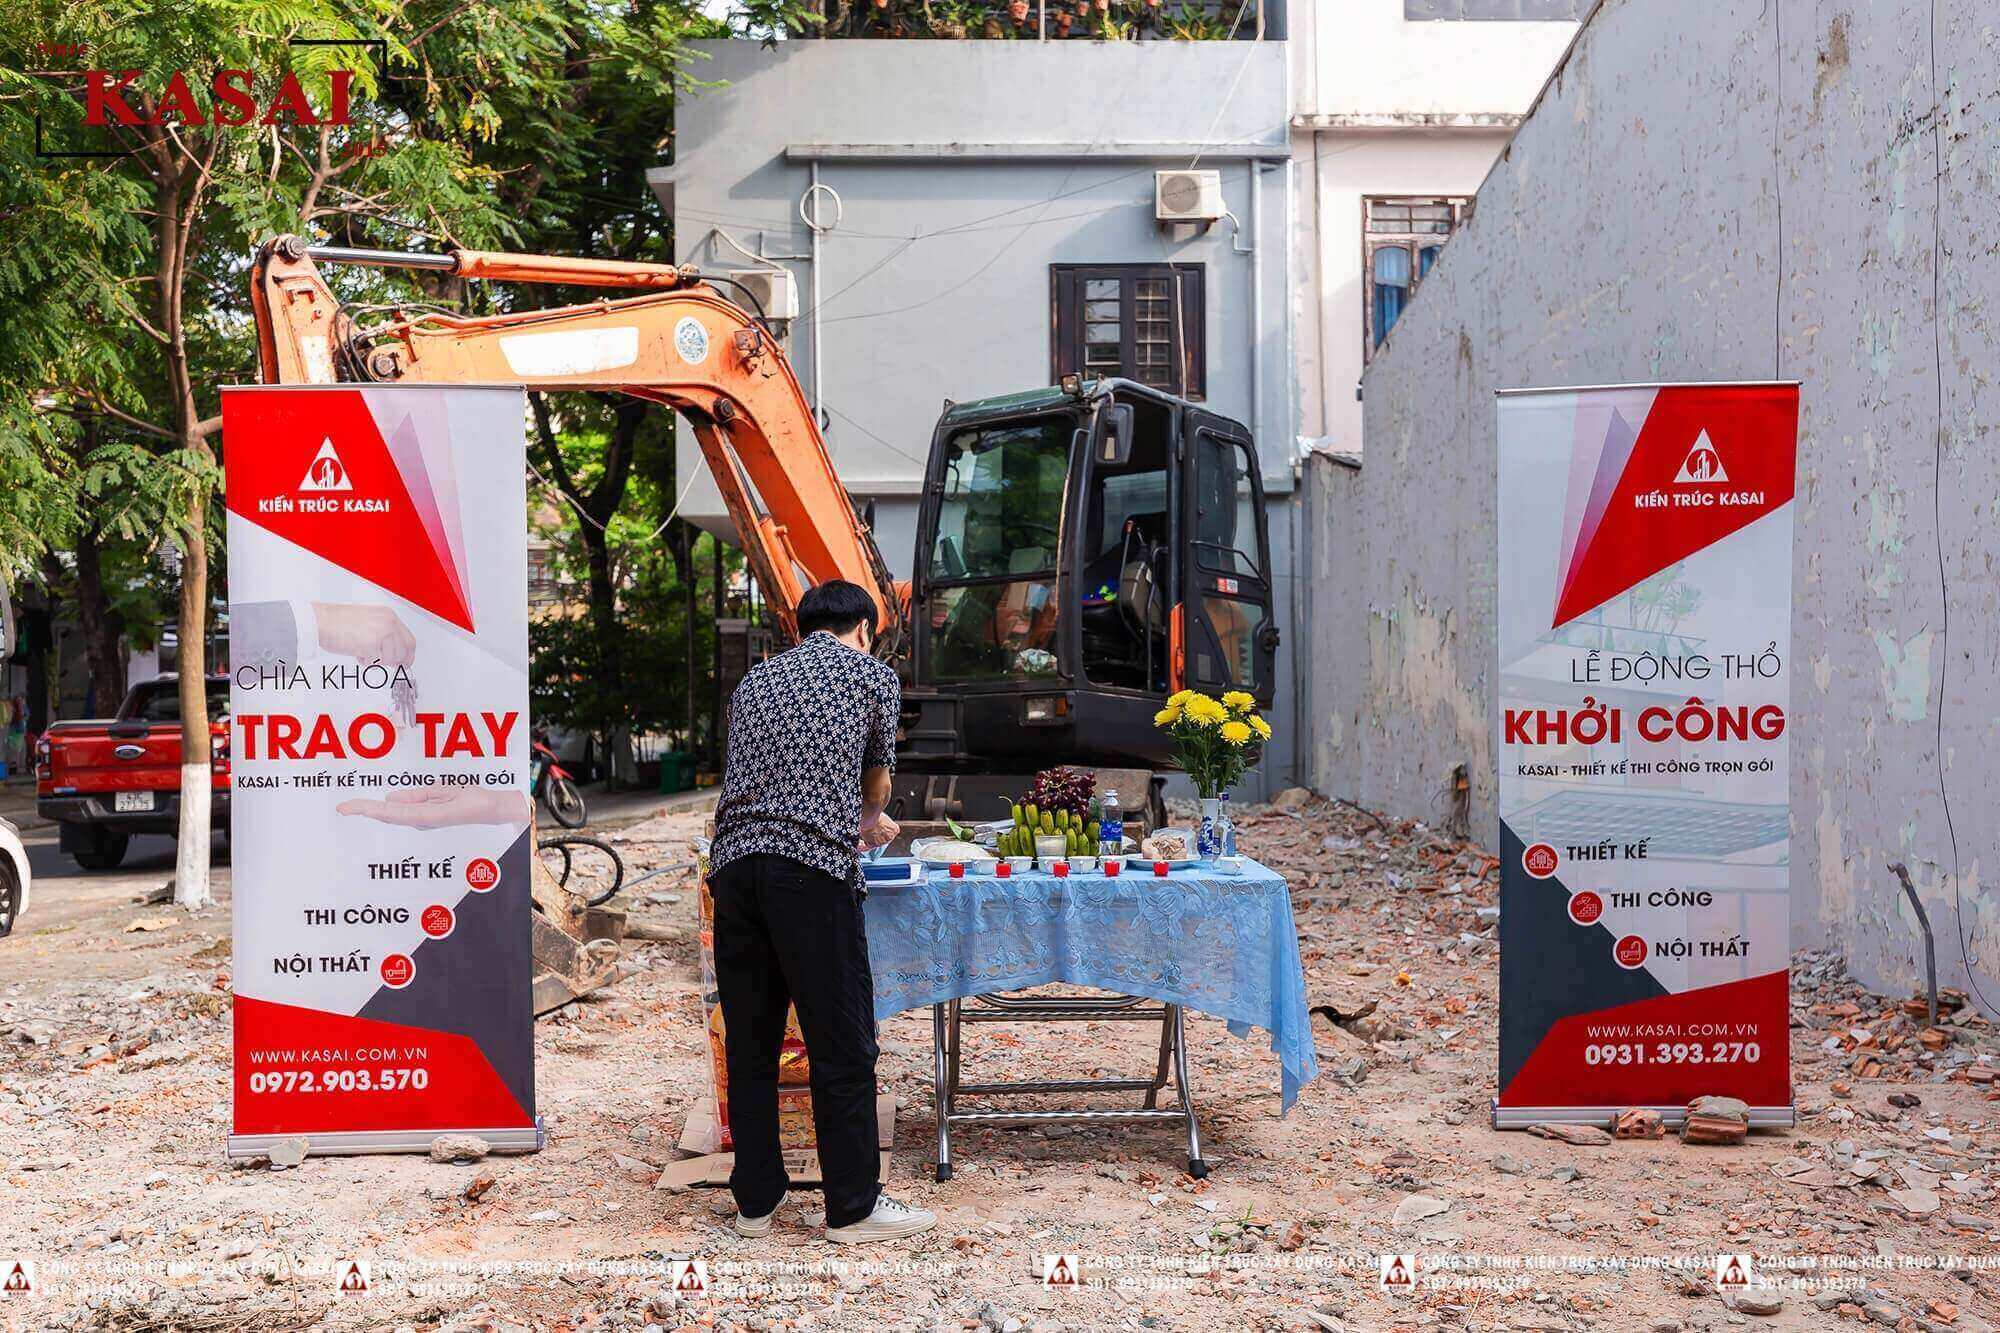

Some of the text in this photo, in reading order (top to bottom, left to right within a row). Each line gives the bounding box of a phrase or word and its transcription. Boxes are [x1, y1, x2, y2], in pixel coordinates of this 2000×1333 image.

[258, 493, 390, 513] KIẾN TRÚC KASAI
[1635, 489, 1764, 508] KIẾN TRÚC KASAI
[236, 658, 413, 690] CHÌA KHÓA
[1572, 640, 1781, 686] LỄ ĐỘNG THỔ
[1504, 696, 1786, 745] KHỞI CÔNG
[236, 711, 519, 760] TRAO TAY
[1518, 765, 1558, 776] KASAI
[1571, 760, 1605, 776] THIẾT
[1611, 759, 1628, 775] KẾ
[1631, 764, 1650, 775] THI
[1656, 759, 1700, 774] CÔNG
[1705, 761, 1743, 776] TRỌN
[1748, 757, 1773, 772] GÓI
[238, 775, 279, 788] KASAI
[293, 770, 332, 788] THIẾT
[337, 770, 358, 787] KẾ
[359, 774, 382, 787] THI
[387, 771, 435, 787] CÔNG
[440, 774, 480, 789] TRỌN
[485, 769, 515, 785] GÓI
[1566, 837, 1650, 861] THIẾT KẾ
[368, 856, 455, 879] THIẾT KẾ
[1611, 888, 1713, 908] THI CÔNG
[304, 904, 410, 925] THI CÔNG
[1655, 935, 1750, 962] NỘI THẤT
[274, 949, 370, 978] NỘI THẤT
[1587, 1023, 1758, 1038] WWW.KASAI.COM.VN
[250, 1047, 427, 1063] WWW.KASAI.COM.VN
[1585, 1042, 1761, 1065] 0931.393.270
[249, 1068, 429, 1093] 0972.903.570
